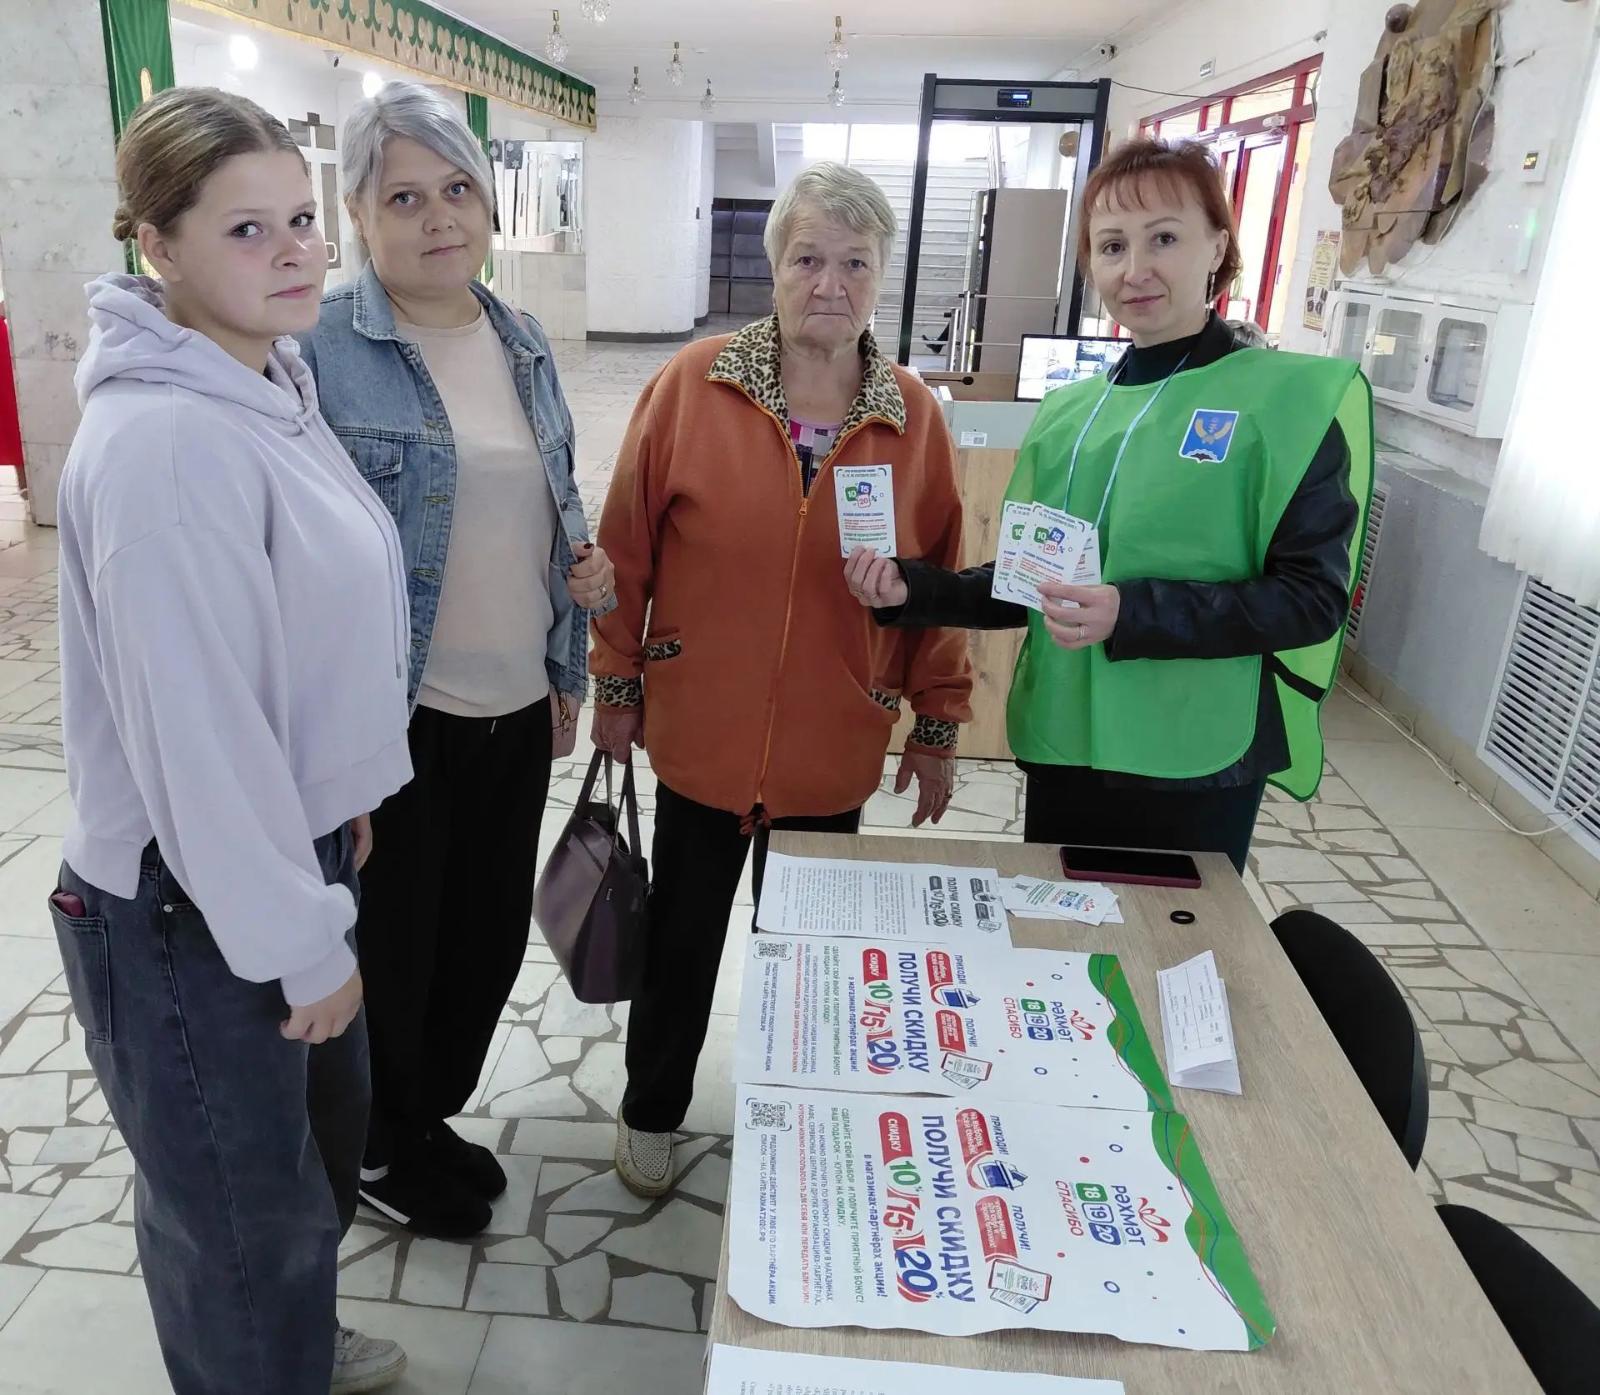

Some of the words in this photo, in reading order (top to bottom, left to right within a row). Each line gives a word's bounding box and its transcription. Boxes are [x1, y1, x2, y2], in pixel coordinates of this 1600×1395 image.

[868, 952, 878, 976] СКИДКУ
[898, 953, 921, 1005] ПОЛУЧИ
[955, 955, 966, 984] ПРИХОДИ!
[848, 982, 858, 1046] магазинах-партнёрах
[1004, 998, 1022, 1038] СПАСИБО
[1025, 1000, 1041, 1009] 18
[1050, 1002, 1073, 1042] РӘХМӘТ
[903, 1010, 929, 1072] СКИДКУ
[965, 1019, 977, 1047] ПОЛУЧИ!
[1032, 1027, 1049, 1039] 20
[850, 1049, 859, 1071] акции!
[841, 1108, 852, 1139] СДЕЛАЙТЕ
[886, 1117, 902, 1151] СКИДКУ
[991, 1116, 1008, 1155] ПРИХОДИ!
[832, 1123, 840, 1153] ПОДАРОК
[836, 1186, 842, 1194] НА
[844, 1141, 854, 1158] СВОЙ
[922, 1116, 956, 1198] ПОЛУЧИ
[845, 1160, 854, 1182] ВЫБОР
[821, 1189, 827, 1197] ПО
[1055, 1180, 1084, 1236] СПАСИБО
[1082, 1185, 1101, 1198] 18
[848, 1193, 858, 1229] ПОЛУЧИТЕ
[1012, 1206, 1031, 1250] ПОЛУЧИ!
[1090, 1206, 1107, 1218] 19
[1111, 1186, 1145, 1245] РӘХМӘТ
[865, 1161, 882, 1258] магазинах-партнёрах
[875, 1262, 887, 1297] акции!
[1095, 1224, 1115, 1242] 20
[851, 1232, 863, 1273] ПРИЯТНЫЙ
[937, 1207, 975, 1302] СКИДКУ
[854, 1276, 863, 1302] БОНУС!
